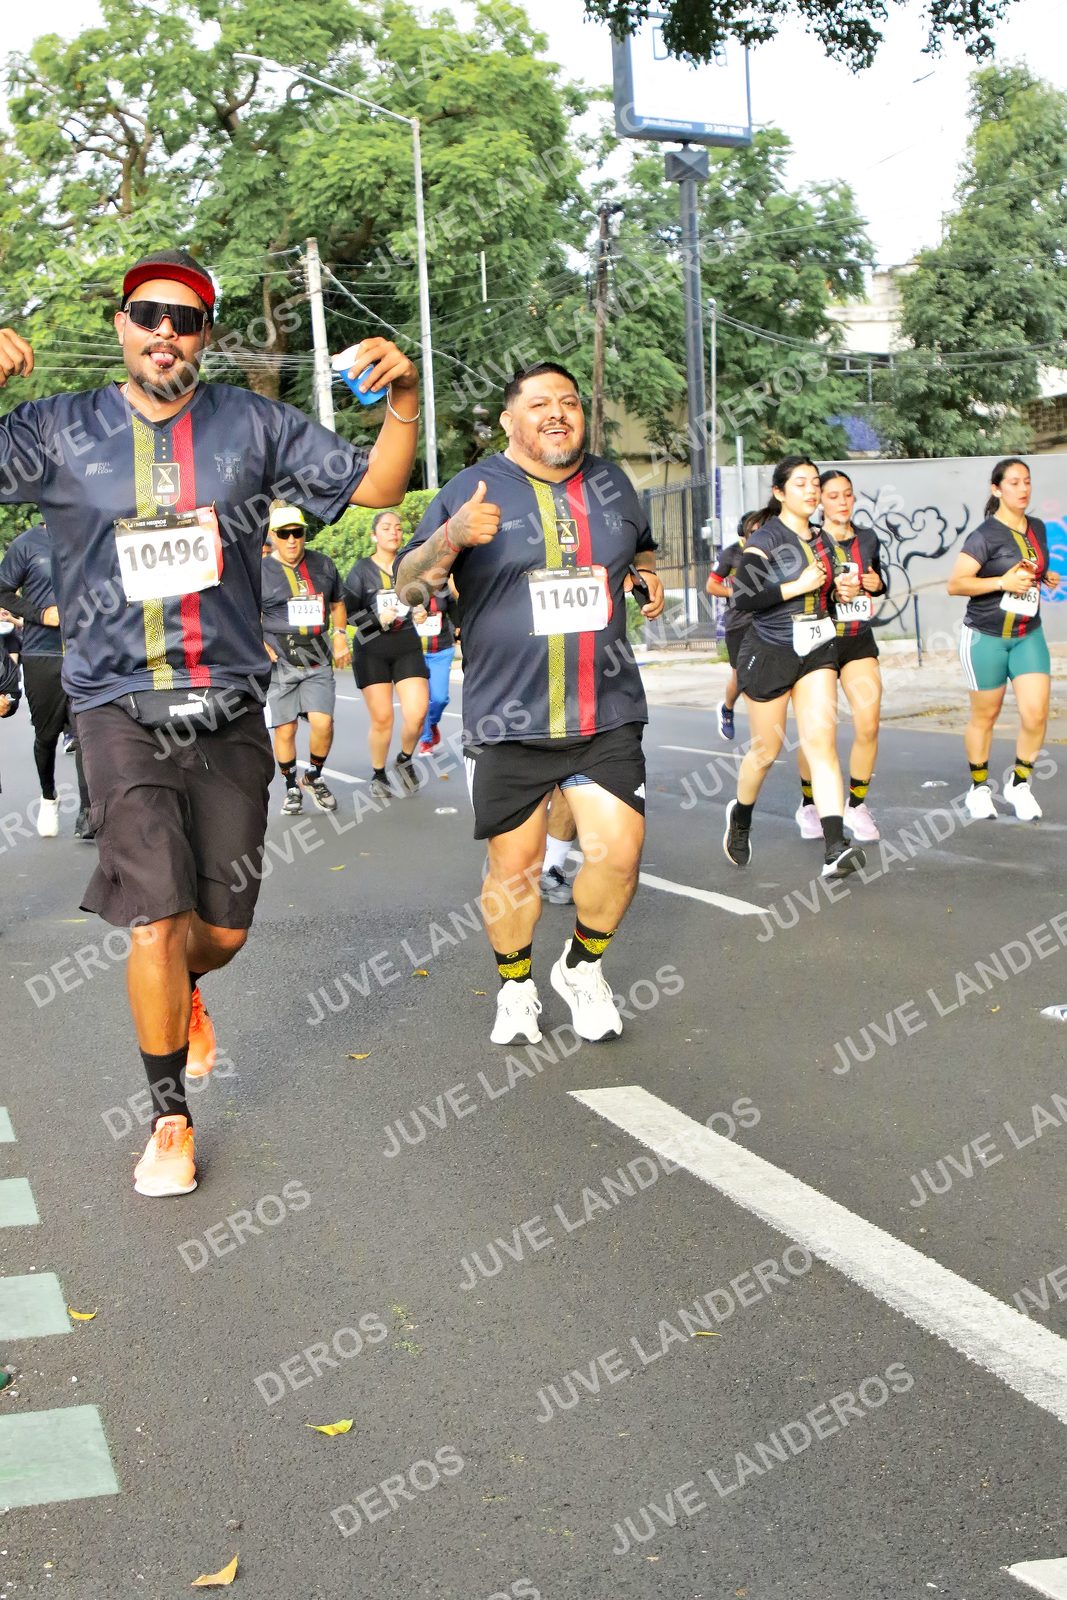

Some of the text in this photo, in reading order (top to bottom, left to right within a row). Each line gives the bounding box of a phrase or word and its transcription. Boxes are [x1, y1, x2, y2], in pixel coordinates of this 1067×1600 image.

[123, 536, 209, 572] 10496
[536, 586, 600, 610] 11407
[810, 626, 822, 640] 79
